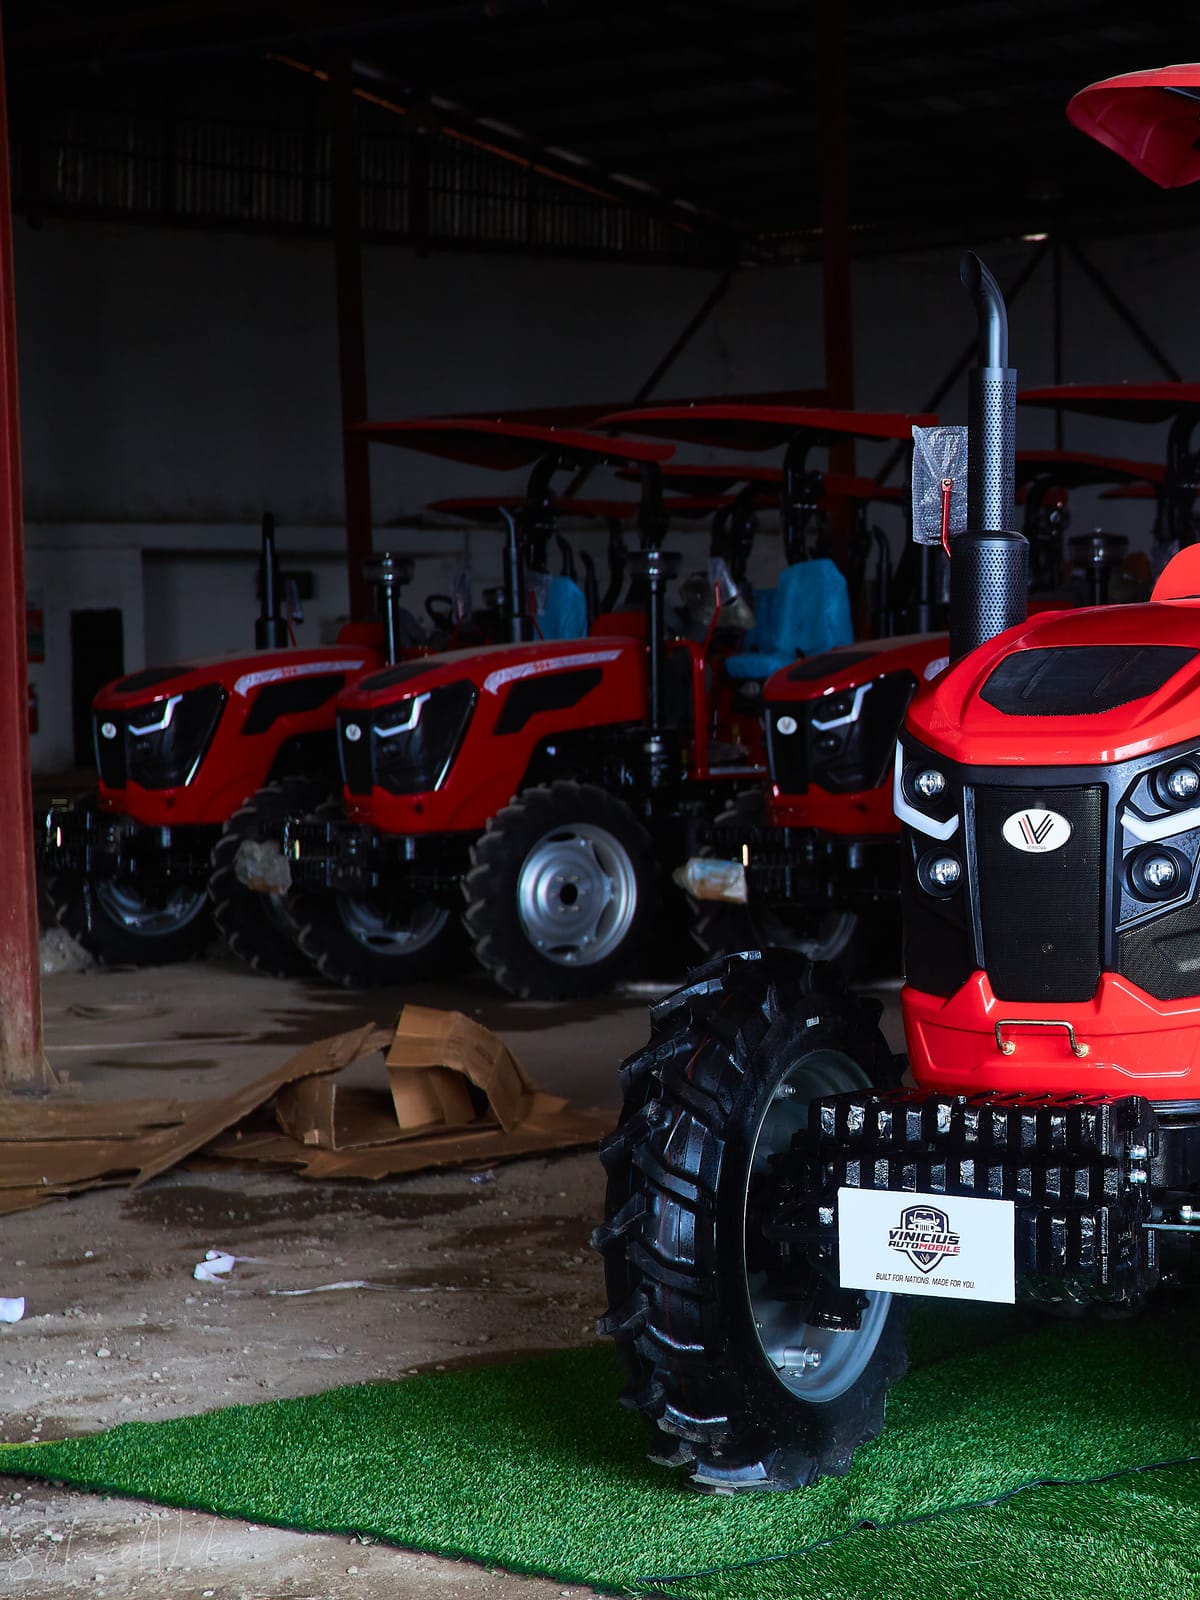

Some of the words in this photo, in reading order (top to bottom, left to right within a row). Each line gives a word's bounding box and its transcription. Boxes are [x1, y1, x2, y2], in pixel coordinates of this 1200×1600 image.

[889, 1230, 960, 1245] VINICIUS
[888, 1241, 960, 1253] AUTOMOBILE
[876, 1272, 891, 1281] BUILT
[892, 1274, 904, 1282] FOR
[905, 1275, 930, 1285] NATIONS.
[932, 1278, 949, 1287] MADE
[950, 1279, 962, 1288] FOR
[962, 1280, 976, 1289] YOU.
